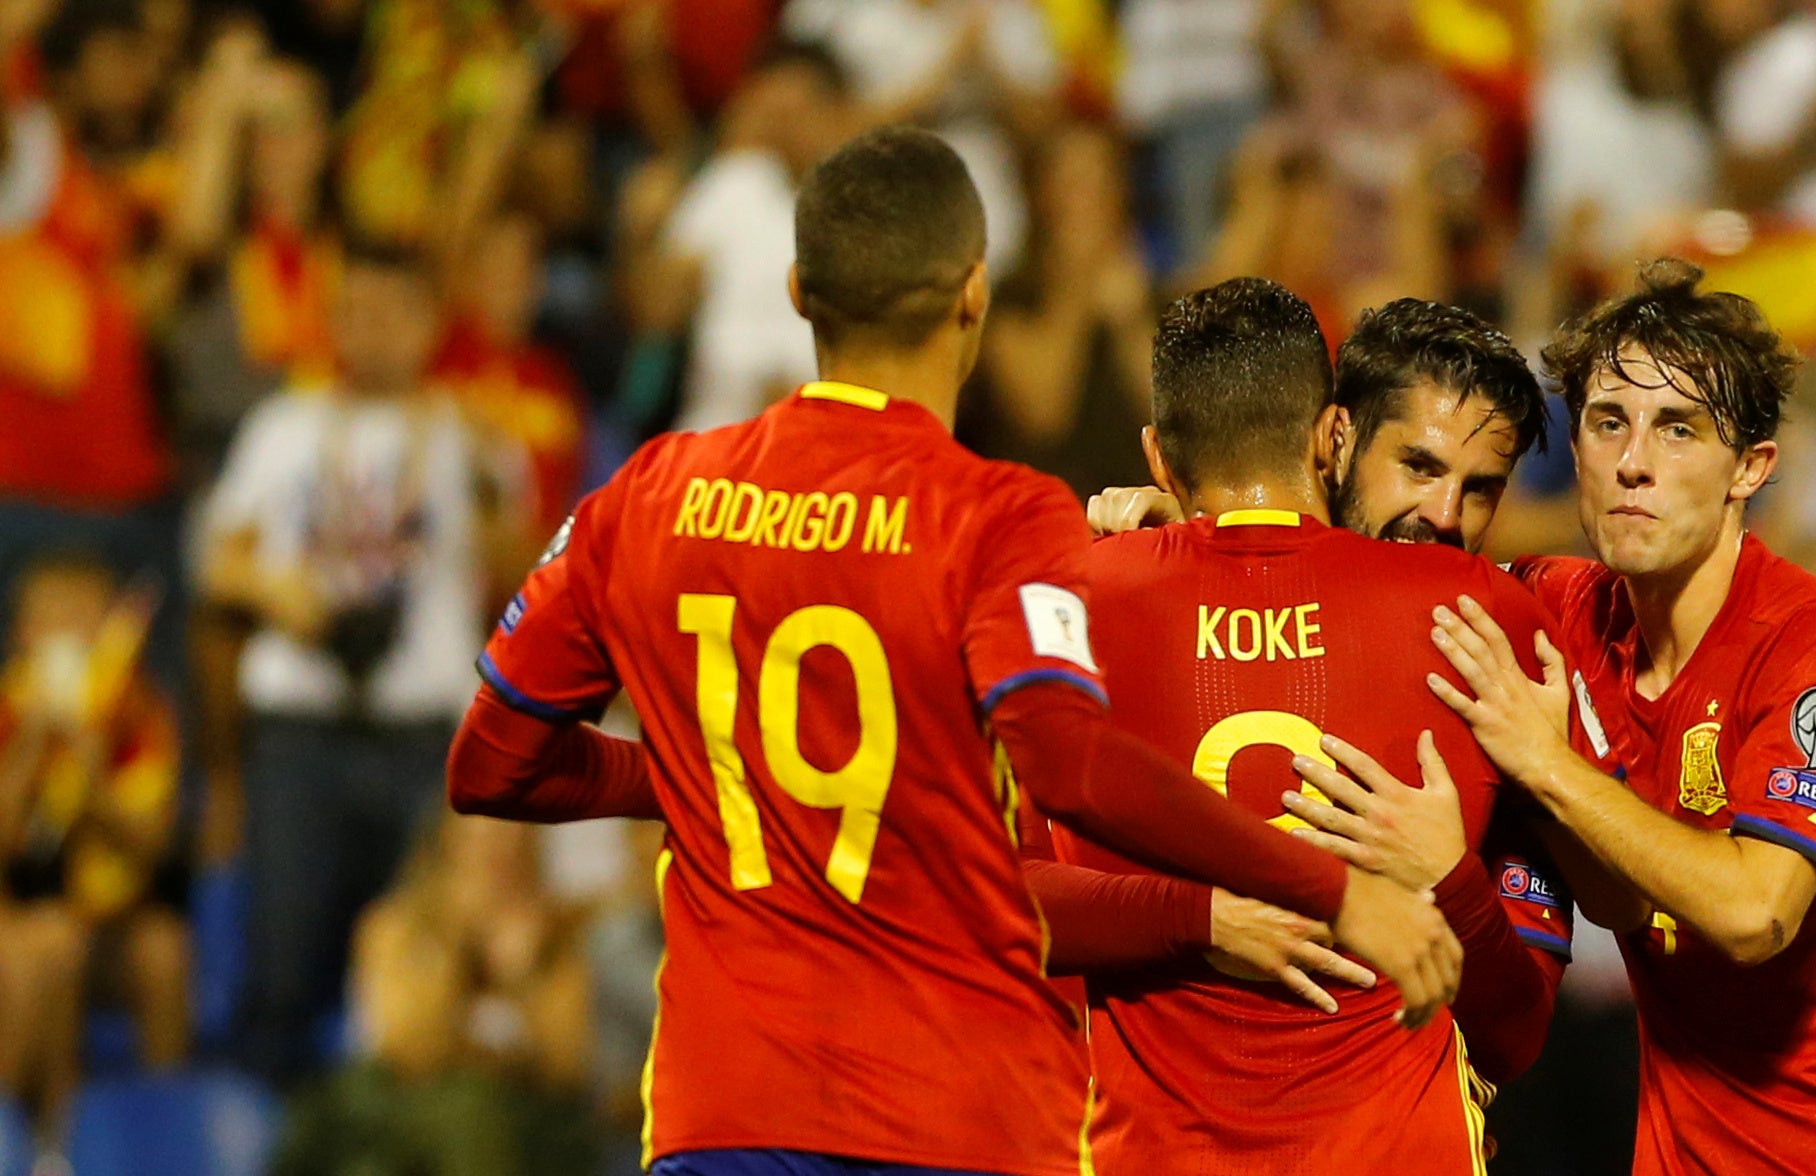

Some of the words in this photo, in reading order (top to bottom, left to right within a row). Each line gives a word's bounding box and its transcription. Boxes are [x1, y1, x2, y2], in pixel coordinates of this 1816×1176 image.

[675, 477, 859, 552] RODRIGO
[862, 496, 912, 555] M.
[1195, 601, 1326, 662] KOKE
[677, 592, 898, 905] 19
